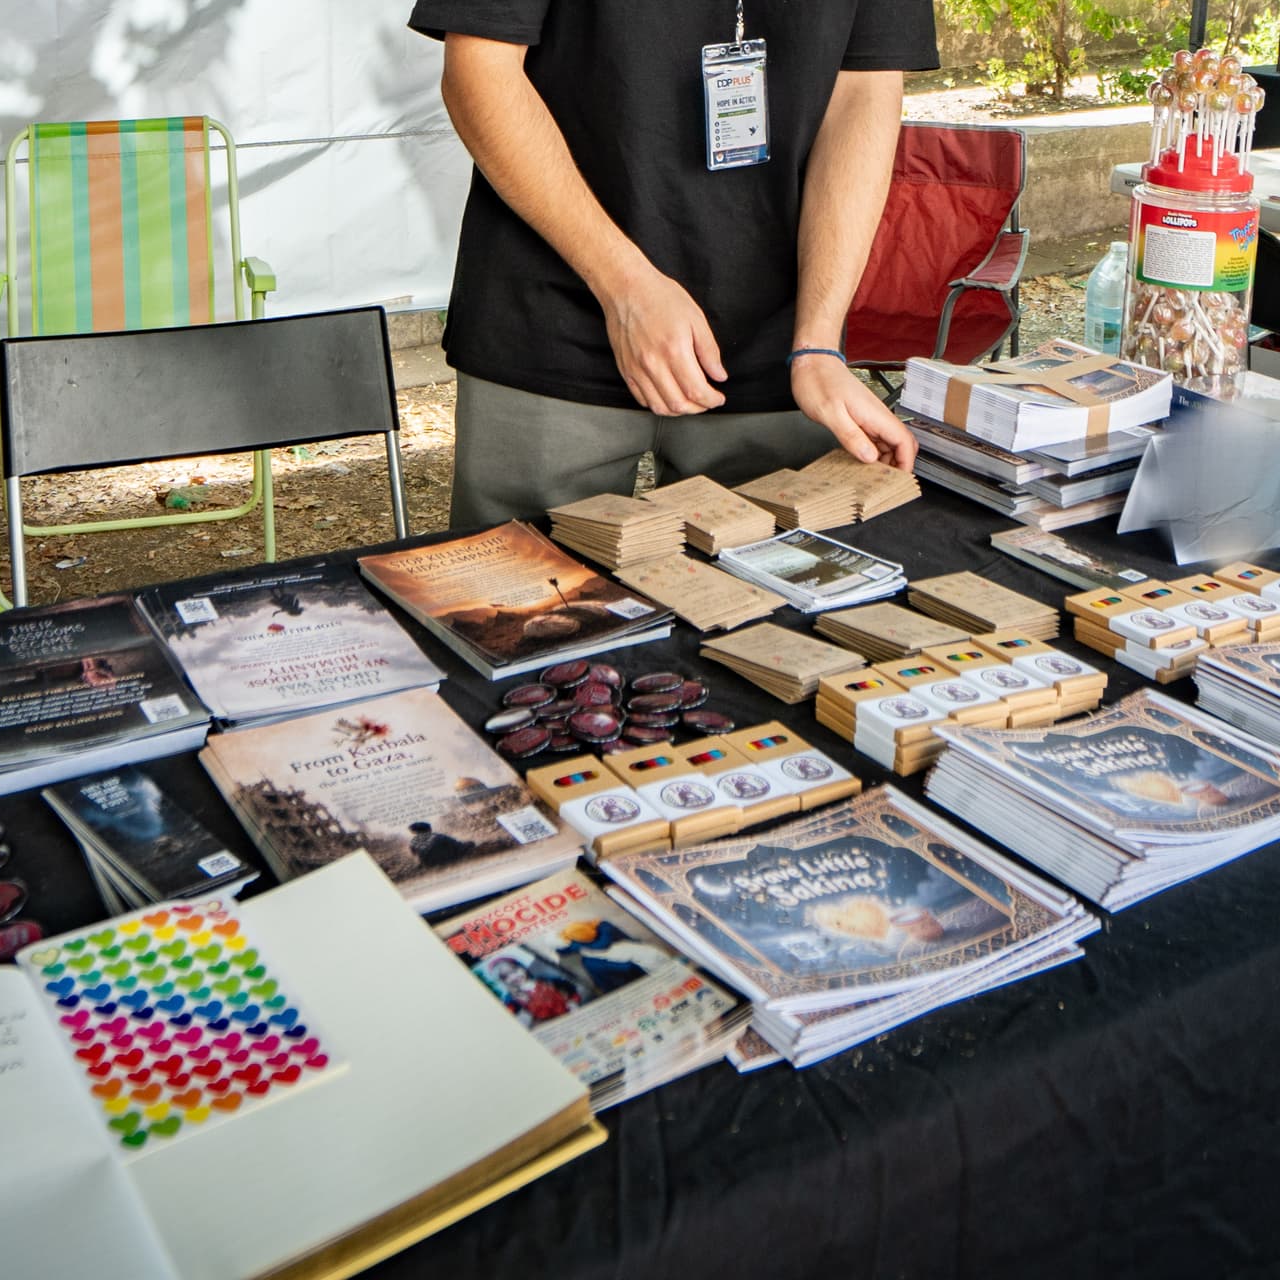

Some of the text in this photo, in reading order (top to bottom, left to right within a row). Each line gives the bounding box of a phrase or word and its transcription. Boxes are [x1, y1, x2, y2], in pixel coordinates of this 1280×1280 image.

[716, 97, 731, 108] HOPE
[732, 96, 738, 107] IN
[1162, 215, 1198, 228] LOLLIPOPS
[388, 535, 507, 570] STOP KILLING THE
[406, 545, 510, 575] KIDS CAMPAIGN
[8, 619, 54, 635] THEIR
[8, 635, 75, 652] BECAME
[362, 656, 391, 669] WE
[245, 667, 311, 688] CHOOSE
[289, 732, 427, 775] From Karbala
[326, 764, 349, 779] to
[798, 851, 871, 876] Little
[767, 872, 877, 907] Sakina
